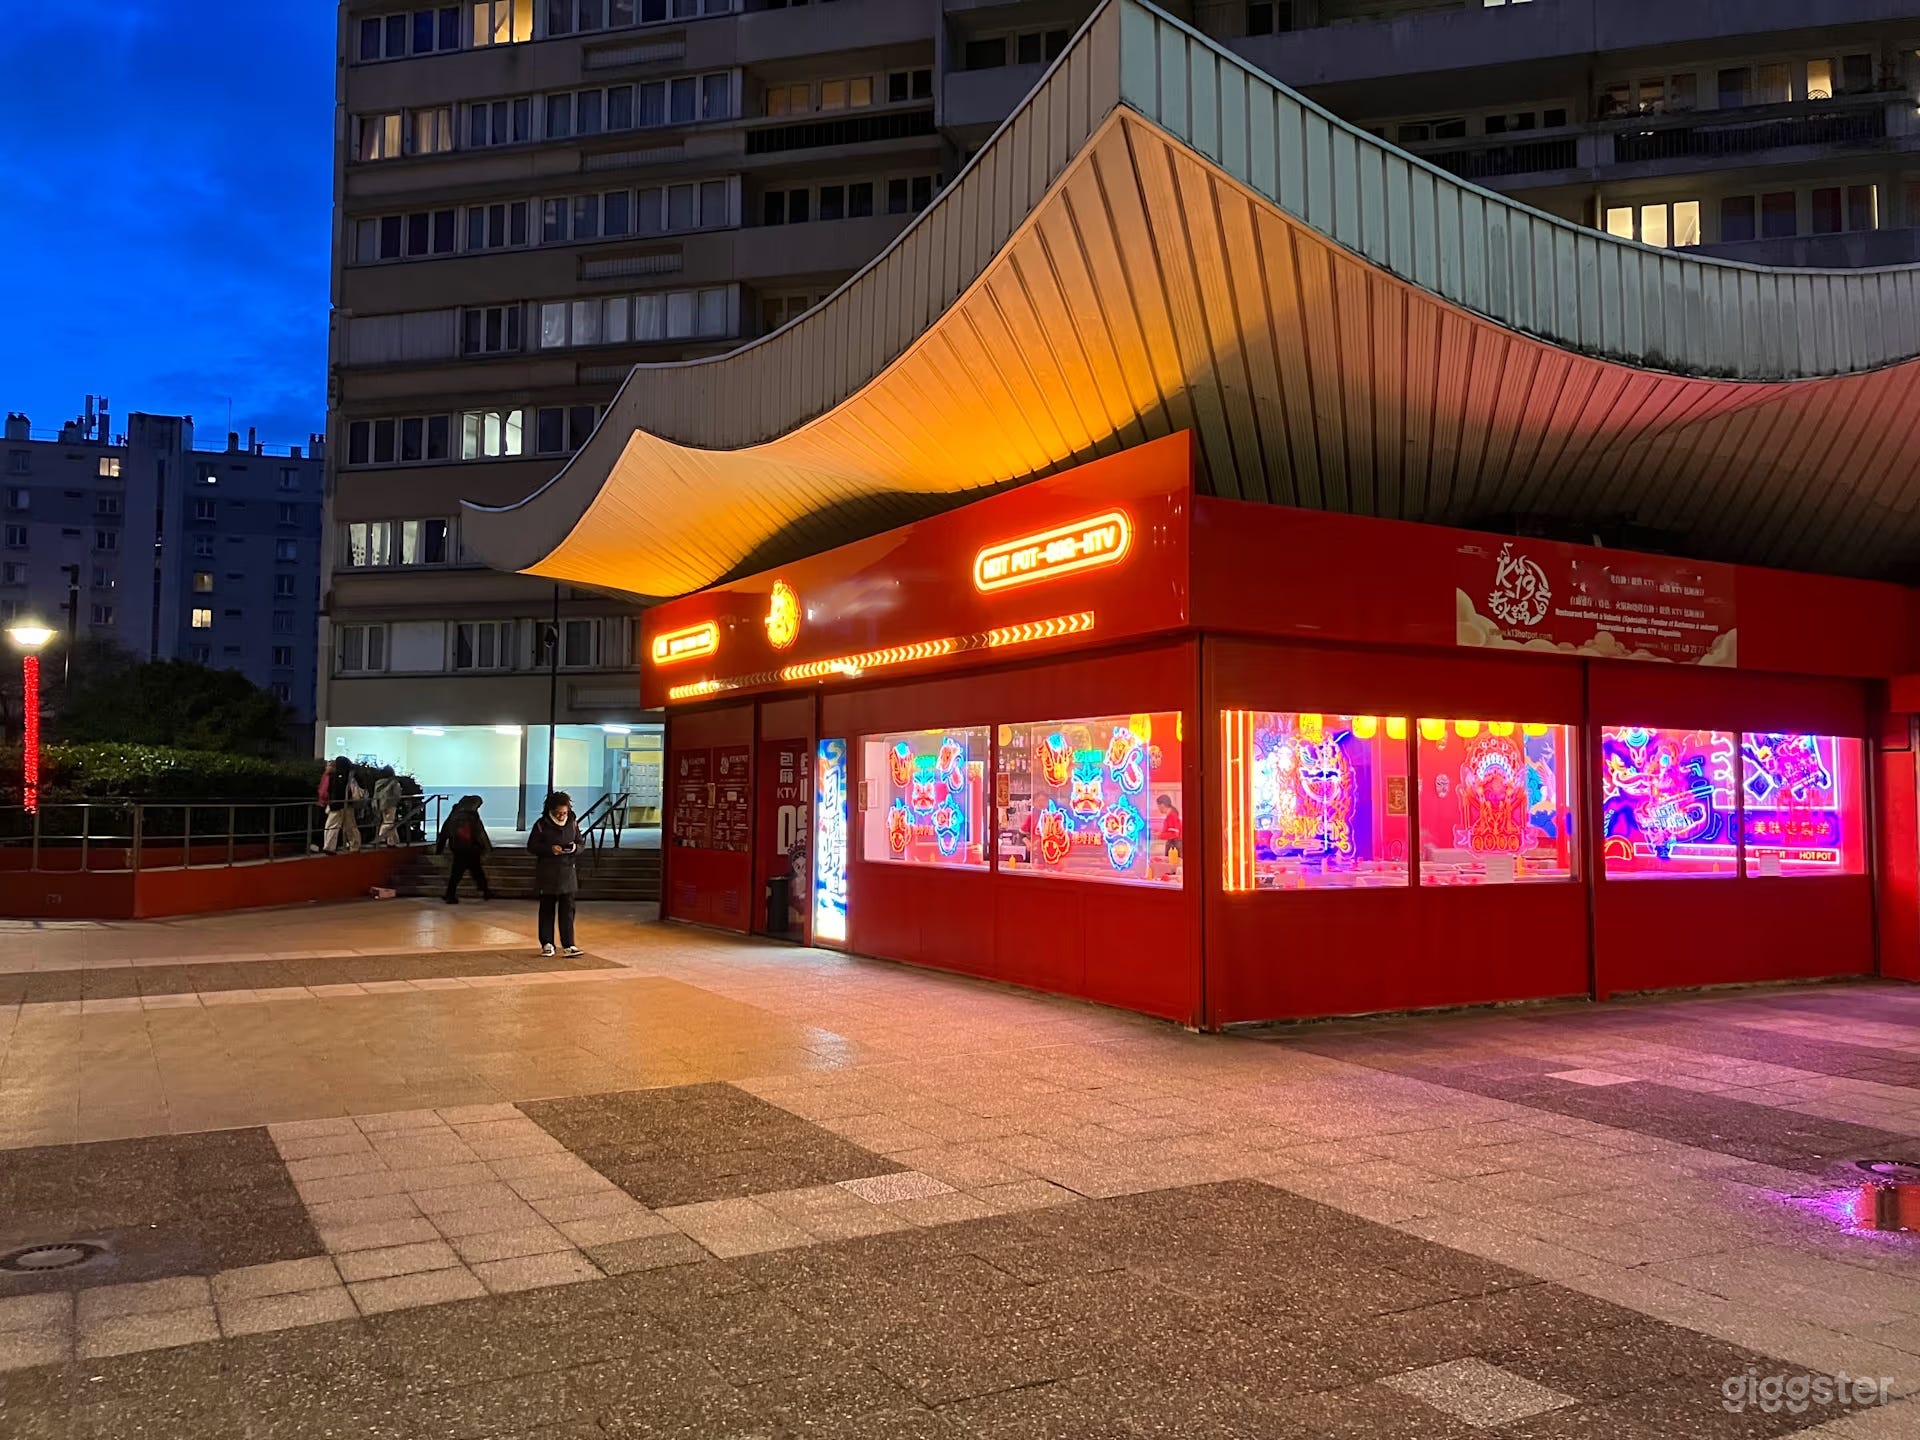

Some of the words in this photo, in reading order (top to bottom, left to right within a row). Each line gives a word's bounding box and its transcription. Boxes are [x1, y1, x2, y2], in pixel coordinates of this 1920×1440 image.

[777, 787, 797, 799] KTV
[1800, 852, 1816, 860] HOT
[1816, 853, 1832, 861] POT
